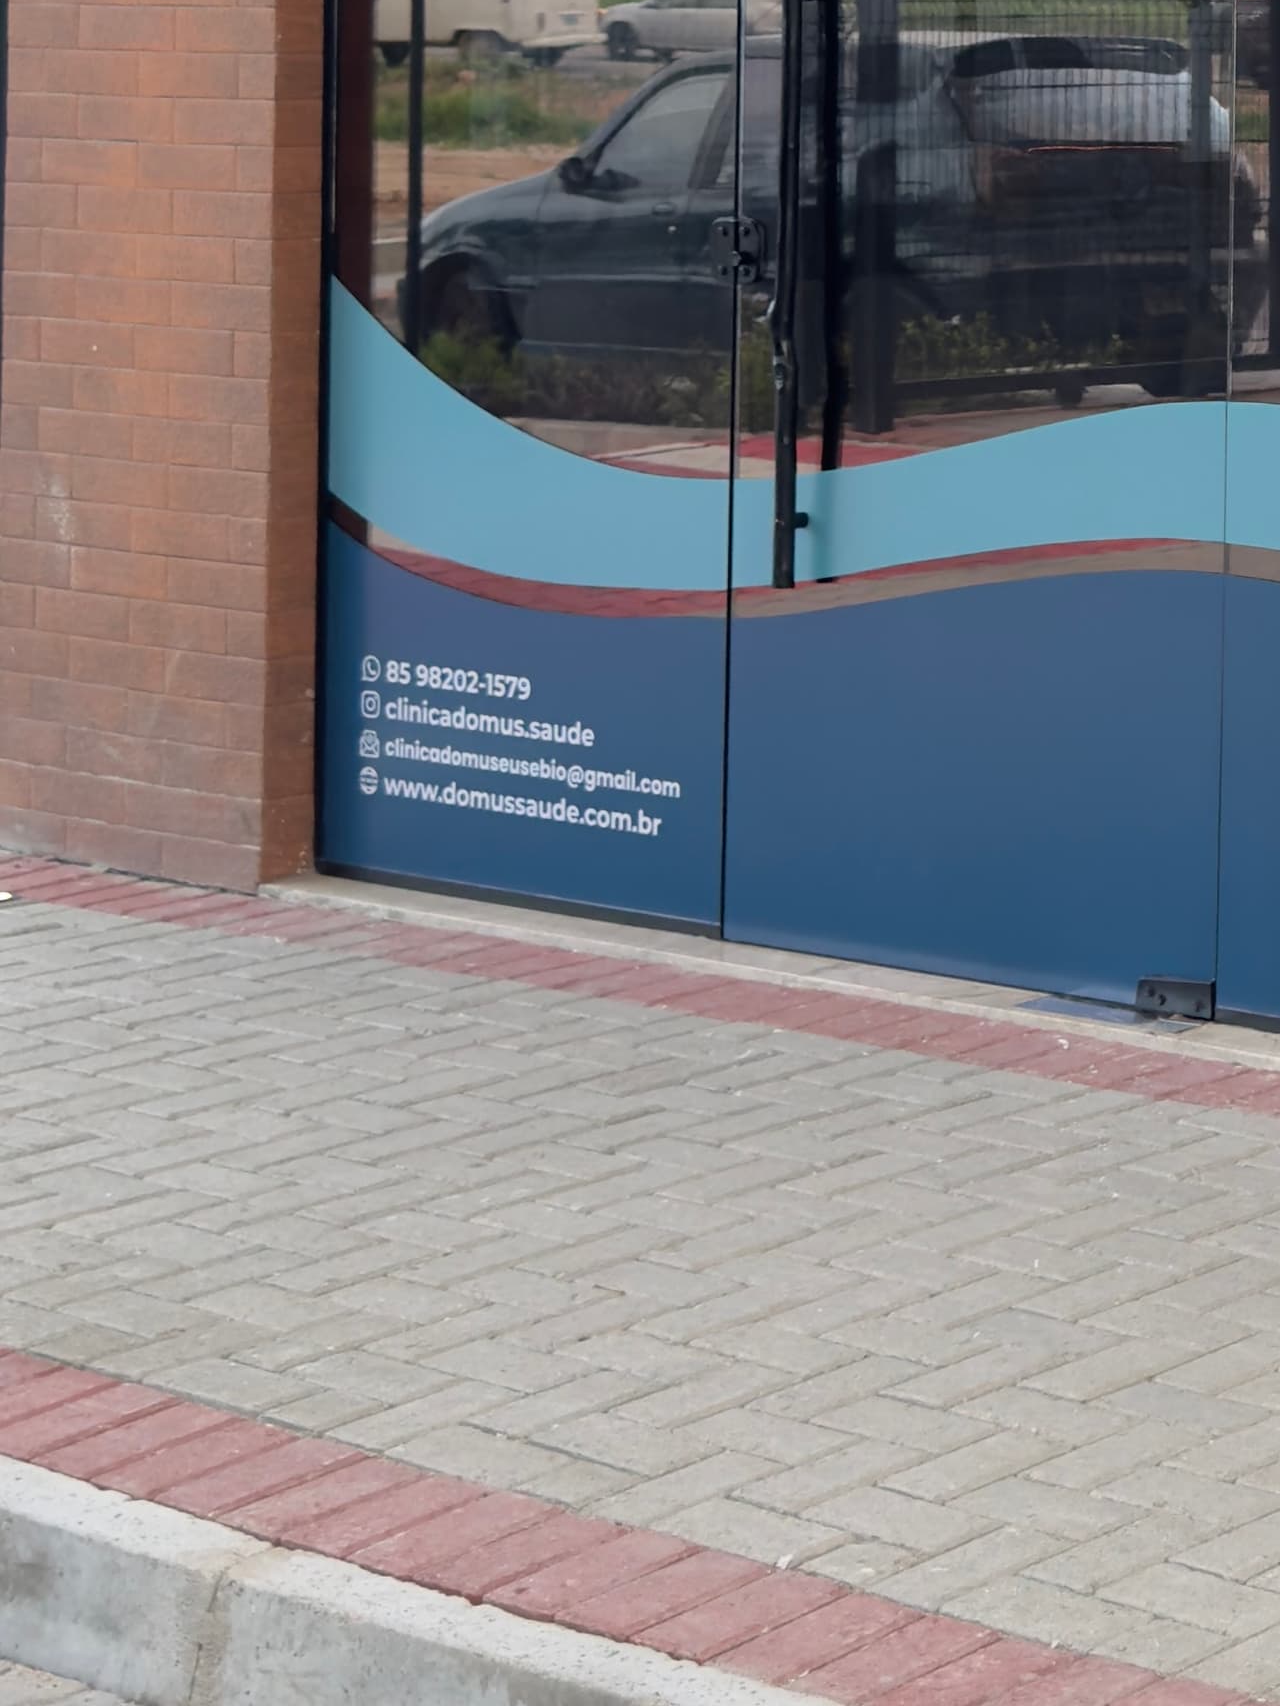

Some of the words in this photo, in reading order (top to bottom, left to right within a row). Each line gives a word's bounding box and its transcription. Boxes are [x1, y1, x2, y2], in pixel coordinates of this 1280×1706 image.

[385, 660, 411, 685] 85
[416, 665, 531, 700] 98202-1579
[385, 698, 595, 746] clinicadomus.saude
[385, 740, 680, 798] clinicadomuseusebio@gmail.com
[384, 777, 662, 836] www.domussaude.com.br
